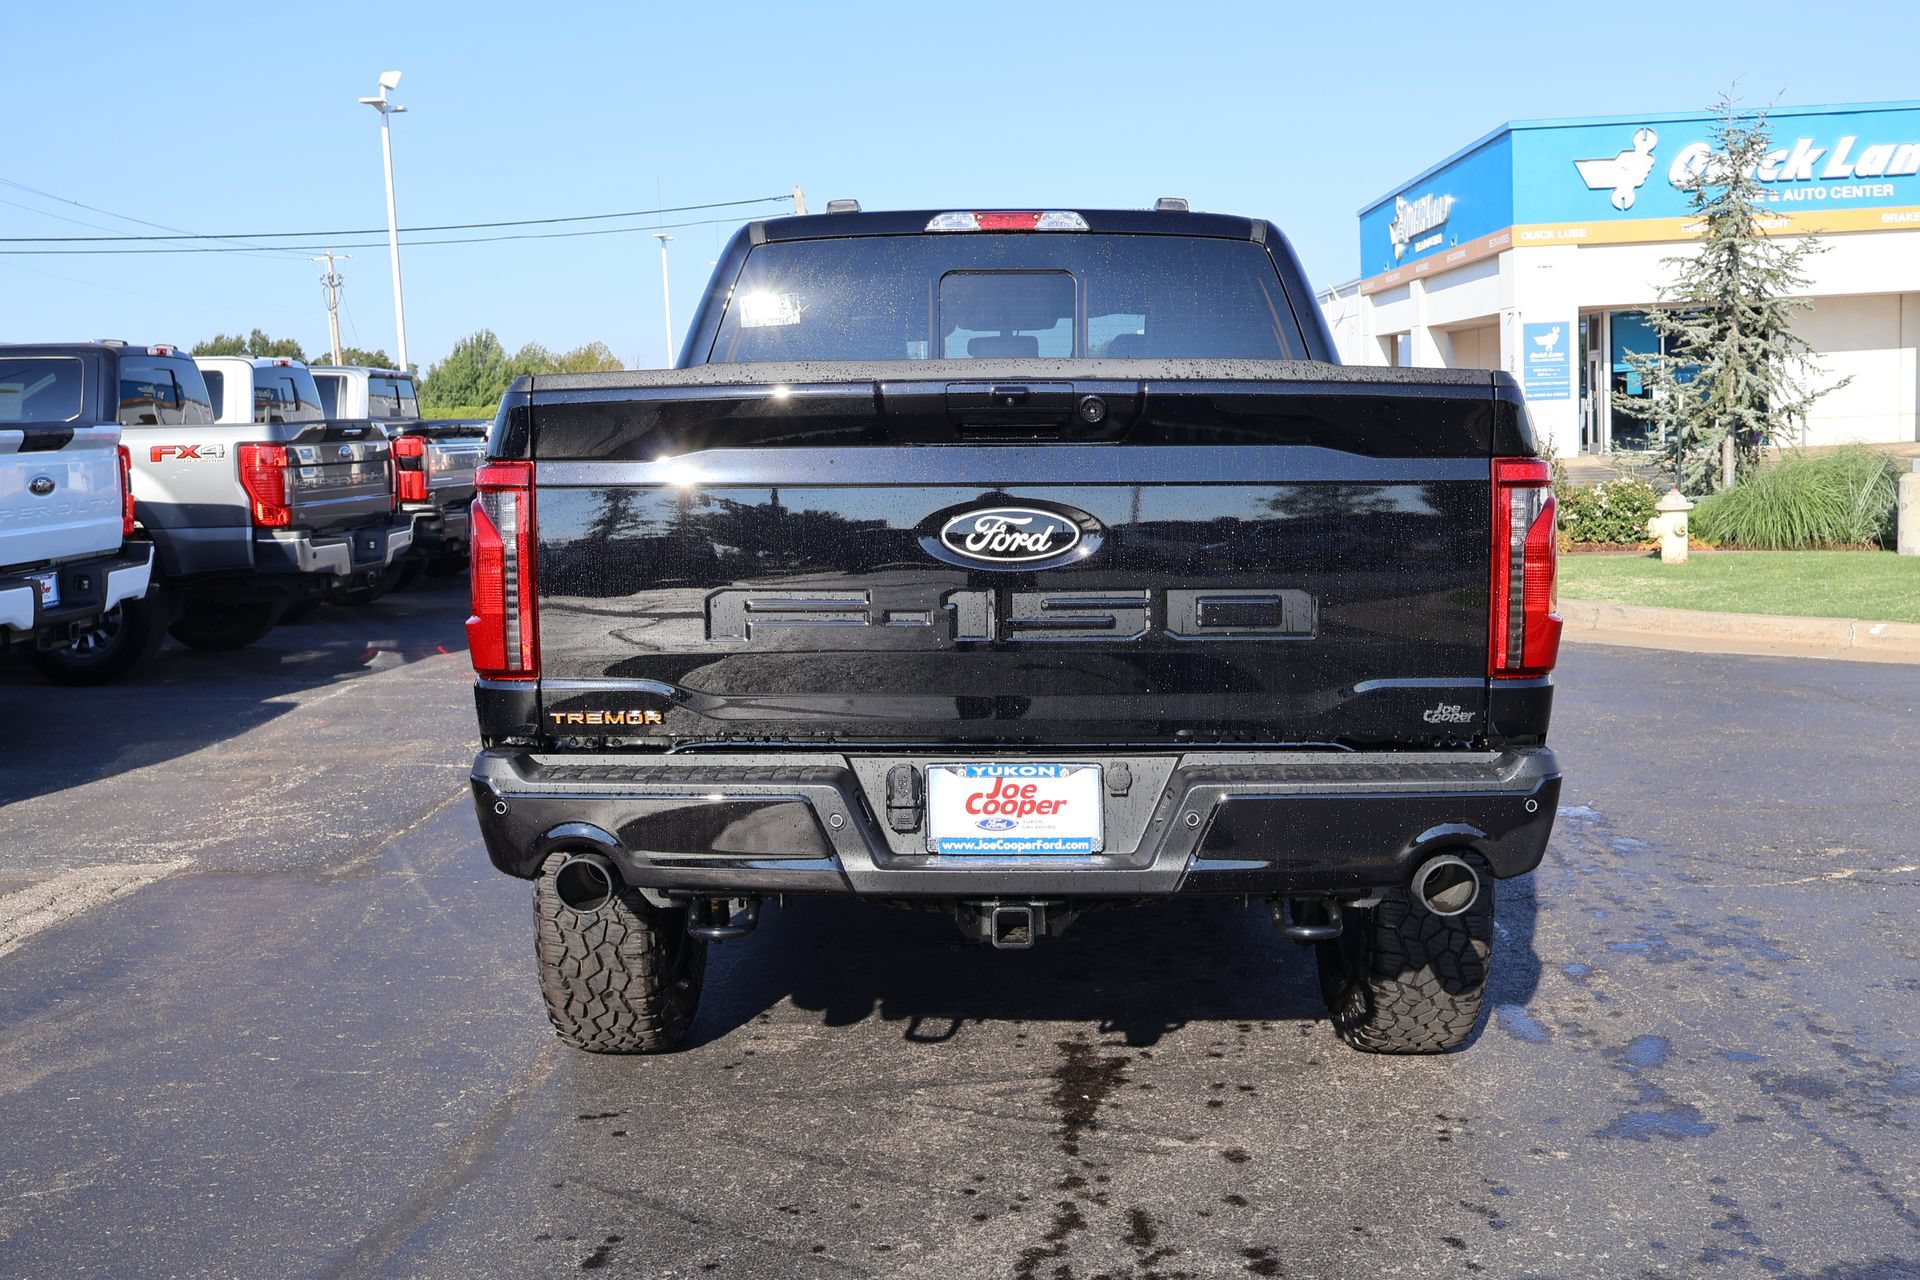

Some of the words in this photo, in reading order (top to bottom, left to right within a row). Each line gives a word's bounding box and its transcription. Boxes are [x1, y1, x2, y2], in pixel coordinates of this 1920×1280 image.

[1783, 187, 1827, 201] AUTO
[1830, 183, 1894, 199] CENTER
[1520, 229, 1555, 241] QUICK
[1557, 228, 1588, 239] LUBE
[150, 444, 225, 462] FX4
[965, 515, 1055, 552] Ford
[705, 588, 1320, 642] F-150
[1423, 709, 1476, 723] Cooper
[1434, 702, 1461, 714] Joe
[549, 710, 662, 724] TREMOR
[972, 766, 1055, 776] YUKON
[986, 777, 1037, 799] Joe
[965, 792, 1067, 818] Cooper
[942, 838, 1090, 852] www.JoeCooperFord.com
